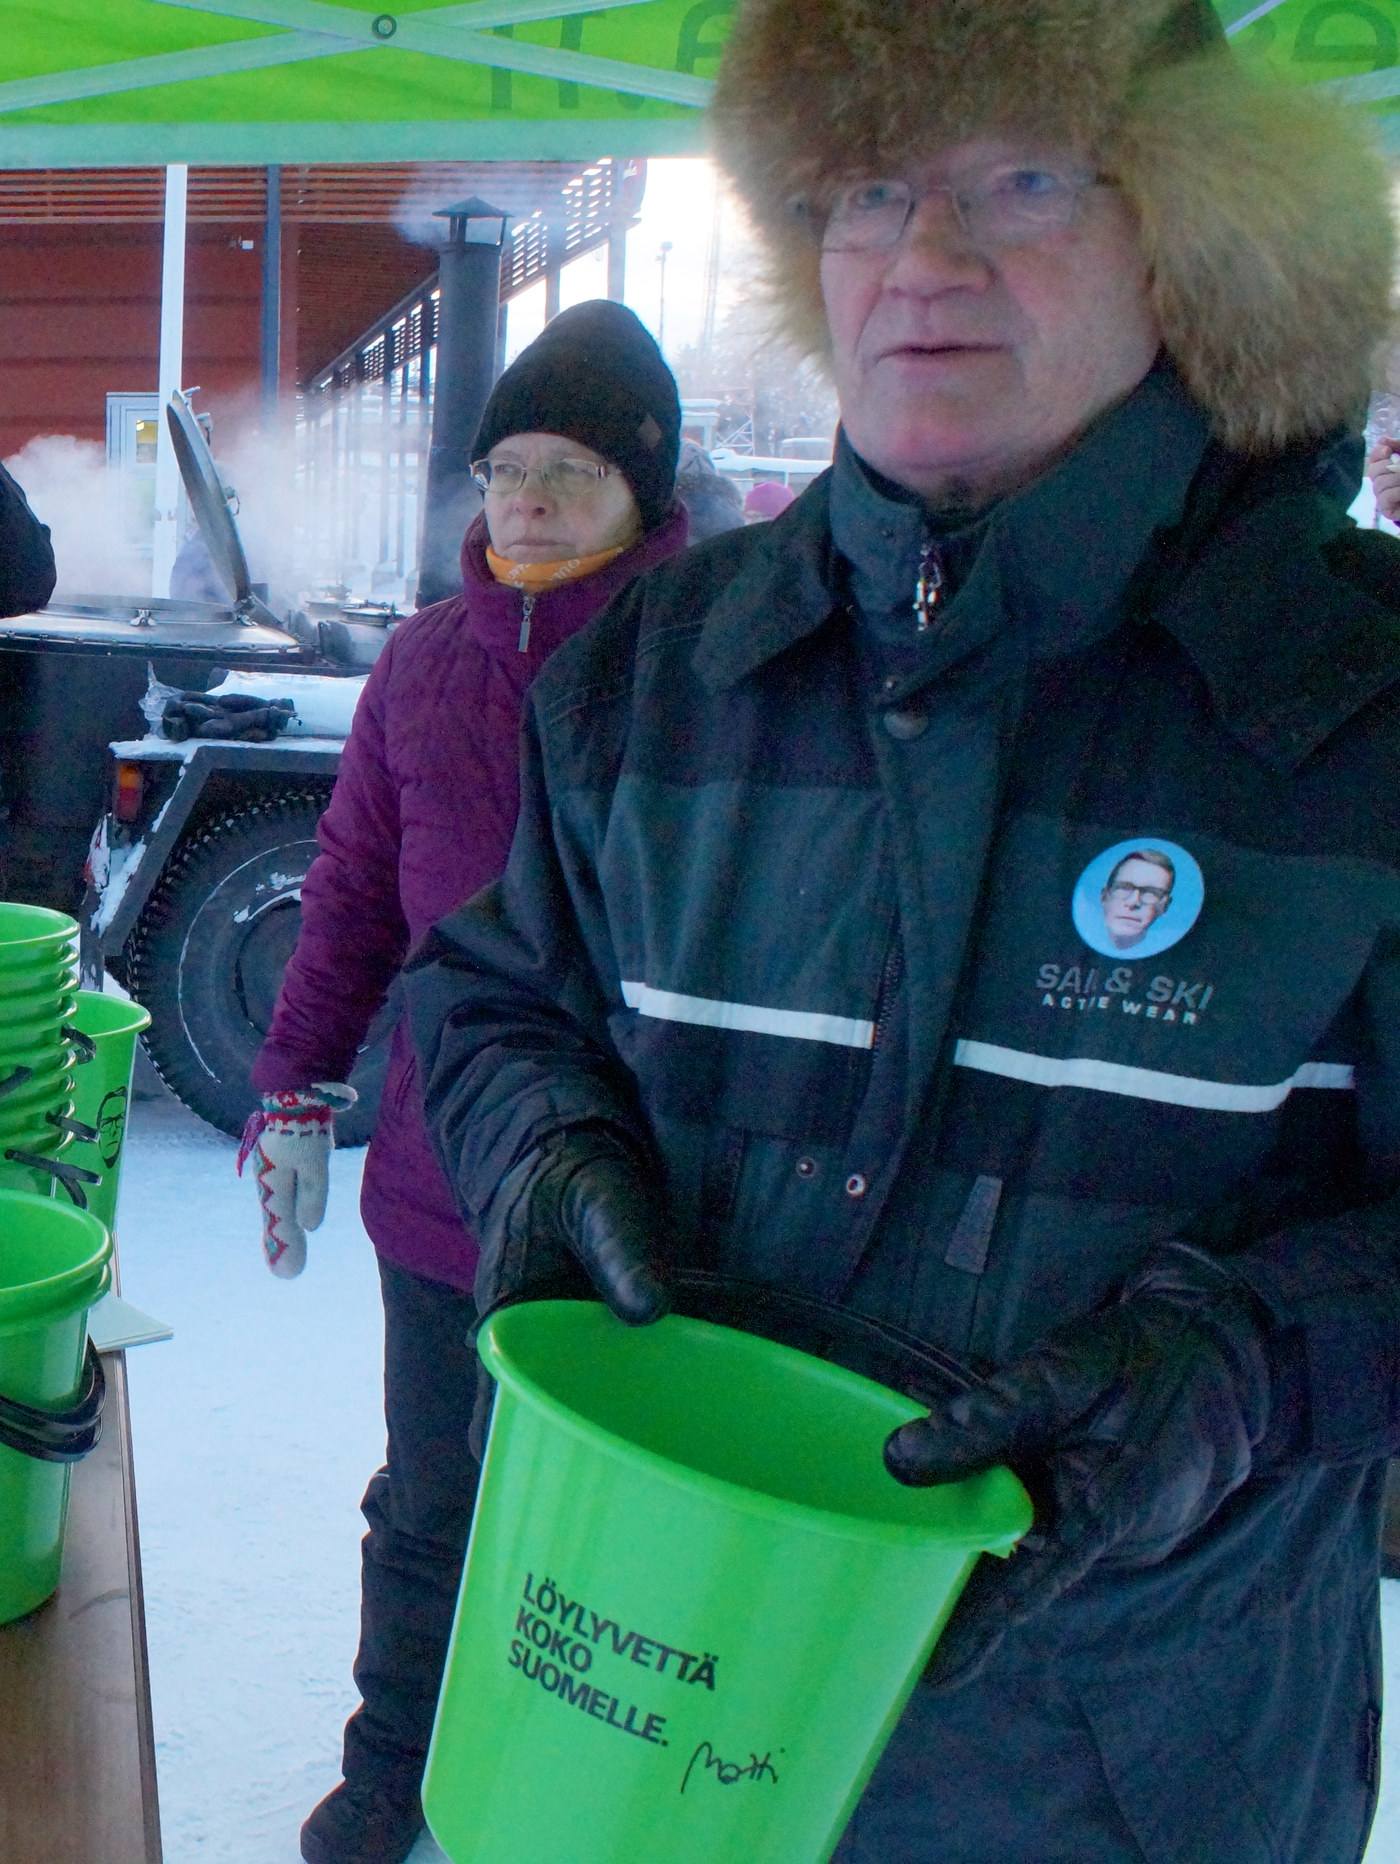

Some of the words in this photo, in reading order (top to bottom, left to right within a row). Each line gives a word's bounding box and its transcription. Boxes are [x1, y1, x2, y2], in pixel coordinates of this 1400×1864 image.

[1122, 999, 1197, 1025] WEAR
[1145, 975, 1214, 1010] SKI
[515, 1604, 593, 1673] KOKO
[522, 1572, 719, 1691] LÖYLYVETTÄ
[508, 1638, 668, 1747] SUOMELLE.
